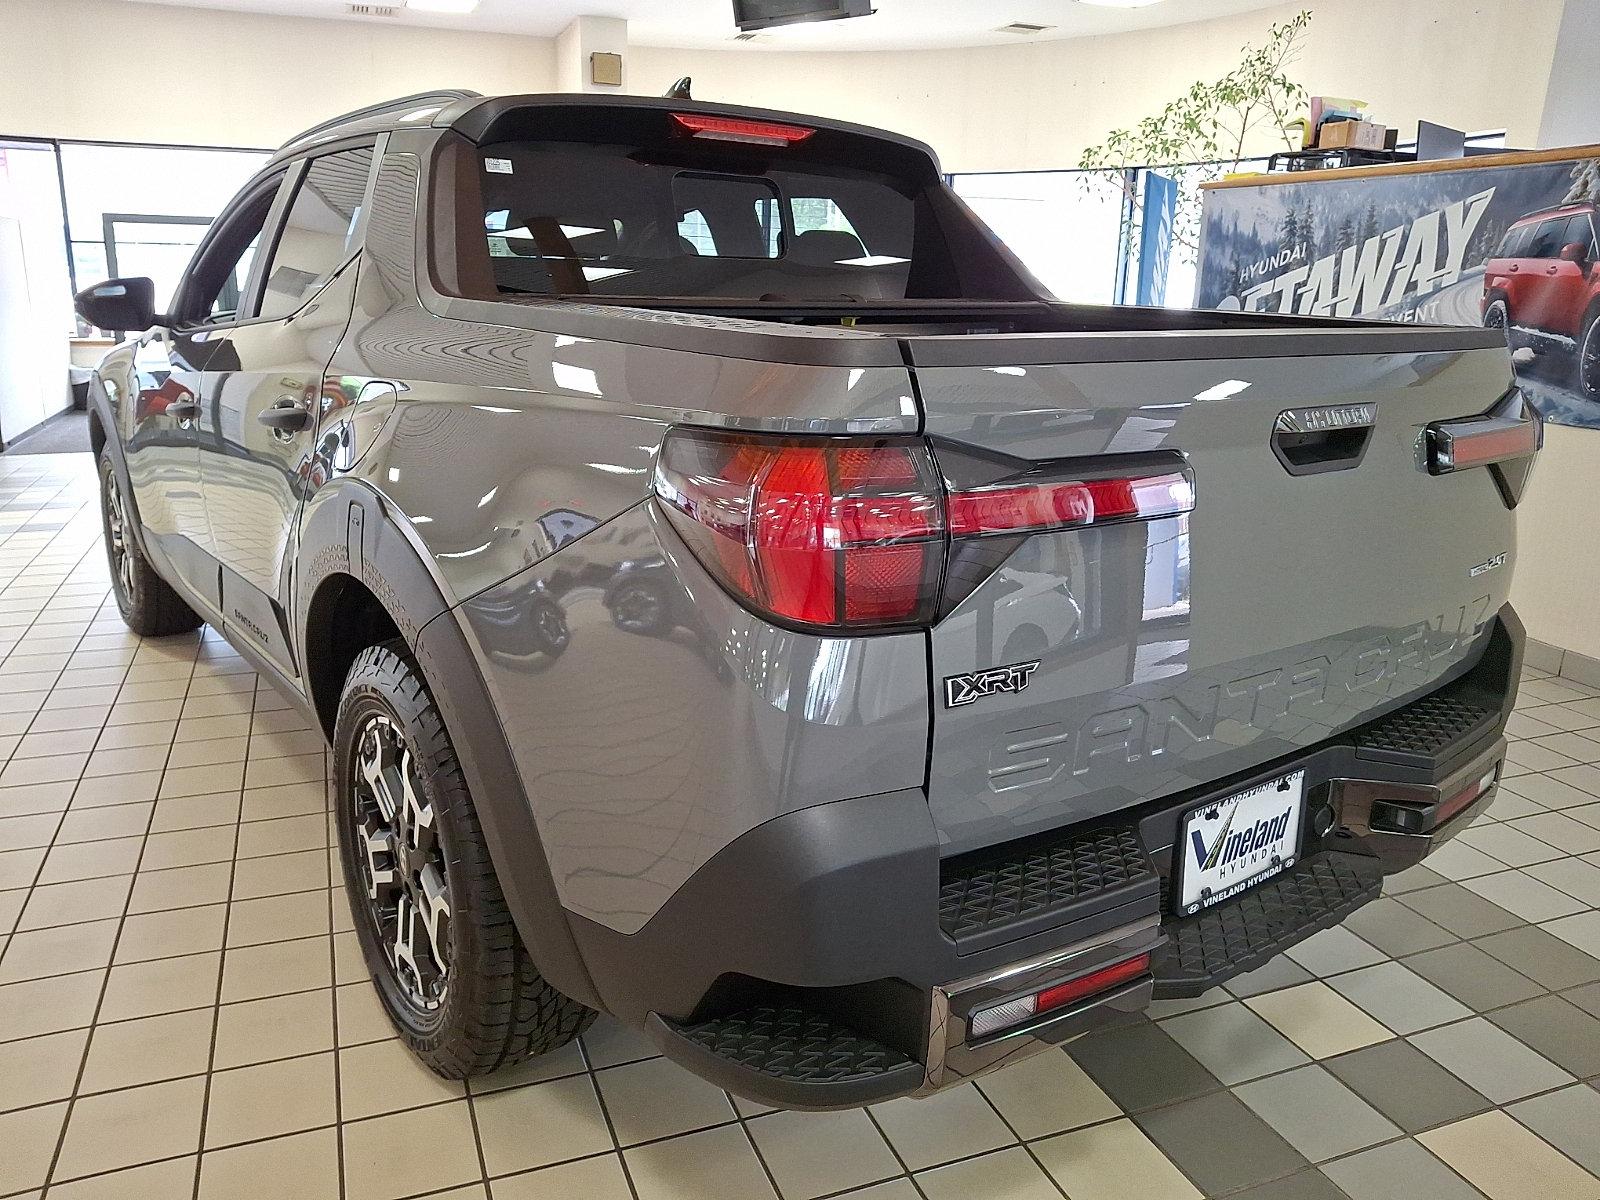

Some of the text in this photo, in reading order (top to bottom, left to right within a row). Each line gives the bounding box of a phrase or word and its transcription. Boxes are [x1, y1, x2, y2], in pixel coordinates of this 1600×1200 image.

[1239, 242, 1306, 284] HYUNDAI
[945, 659, 1042, 708] XRT
[987, 654, 1334, 793] SANTA
[1194, 769, 1305, 818] VINELANDHYUNDAICOM
[1191, 801, 1293, 873] Vineland
[1219, 839, 1285, 880] HYUNDAI
[1203, 864, 1283, 908] VINELAND HYUNDAI
